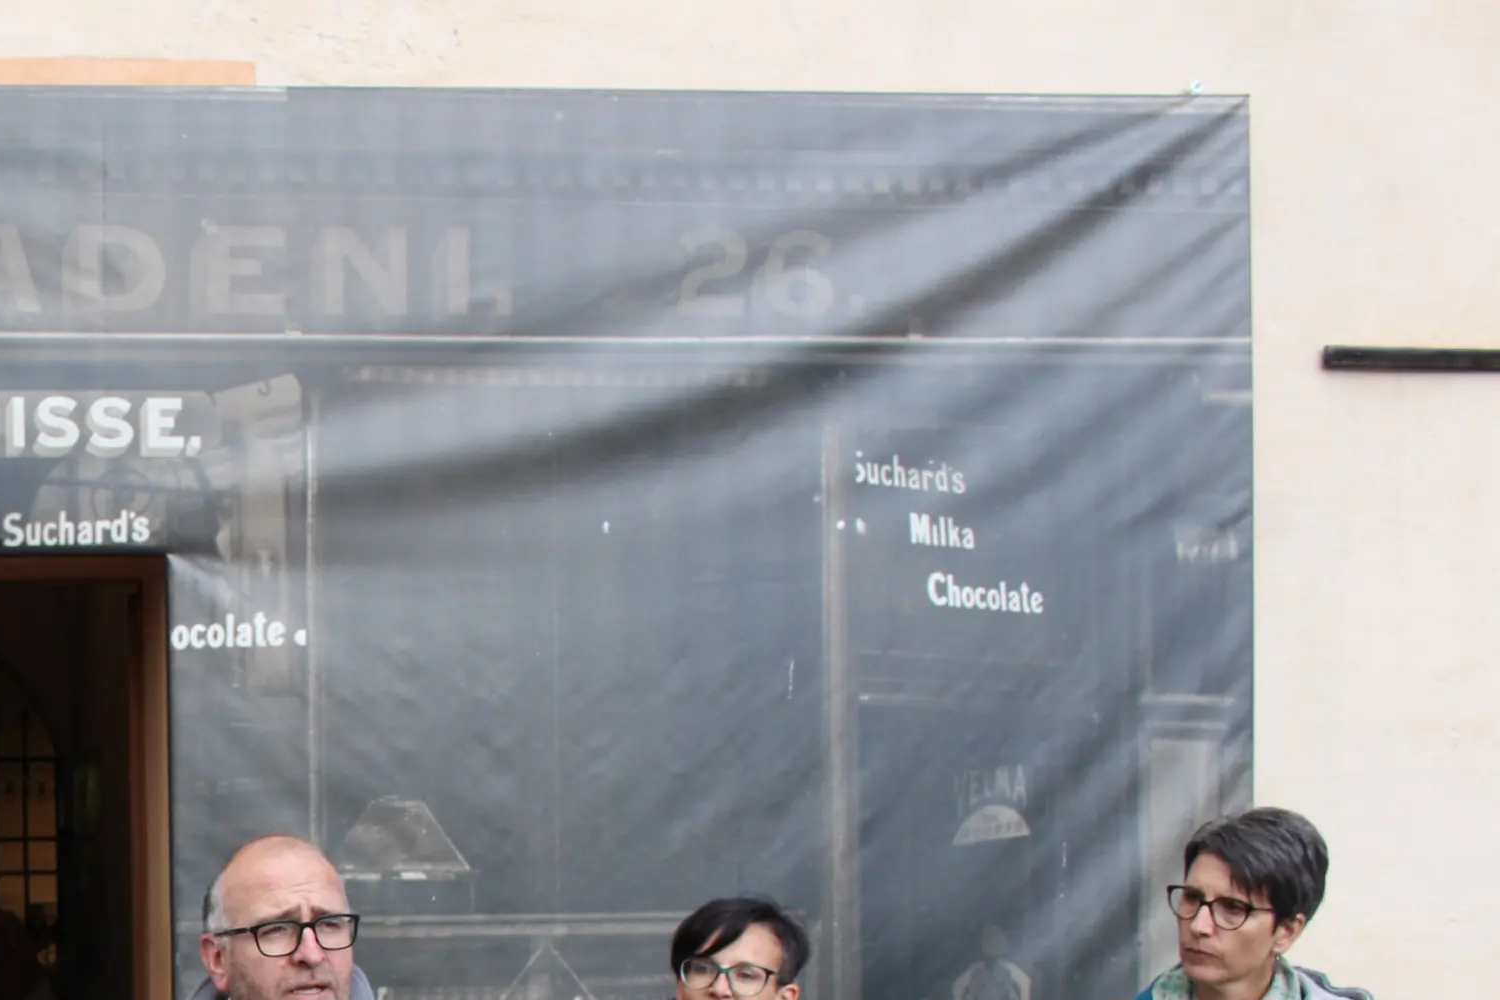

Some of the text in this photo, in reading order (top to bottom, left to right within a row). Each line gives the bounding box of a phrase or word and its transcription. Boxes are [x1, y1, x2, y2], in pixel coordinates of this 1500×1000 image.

[2, 509, 151, 548] Suchard's
[908, 511, 976, 550] Milka
[926, 571, 1045, 615] Chocolate
